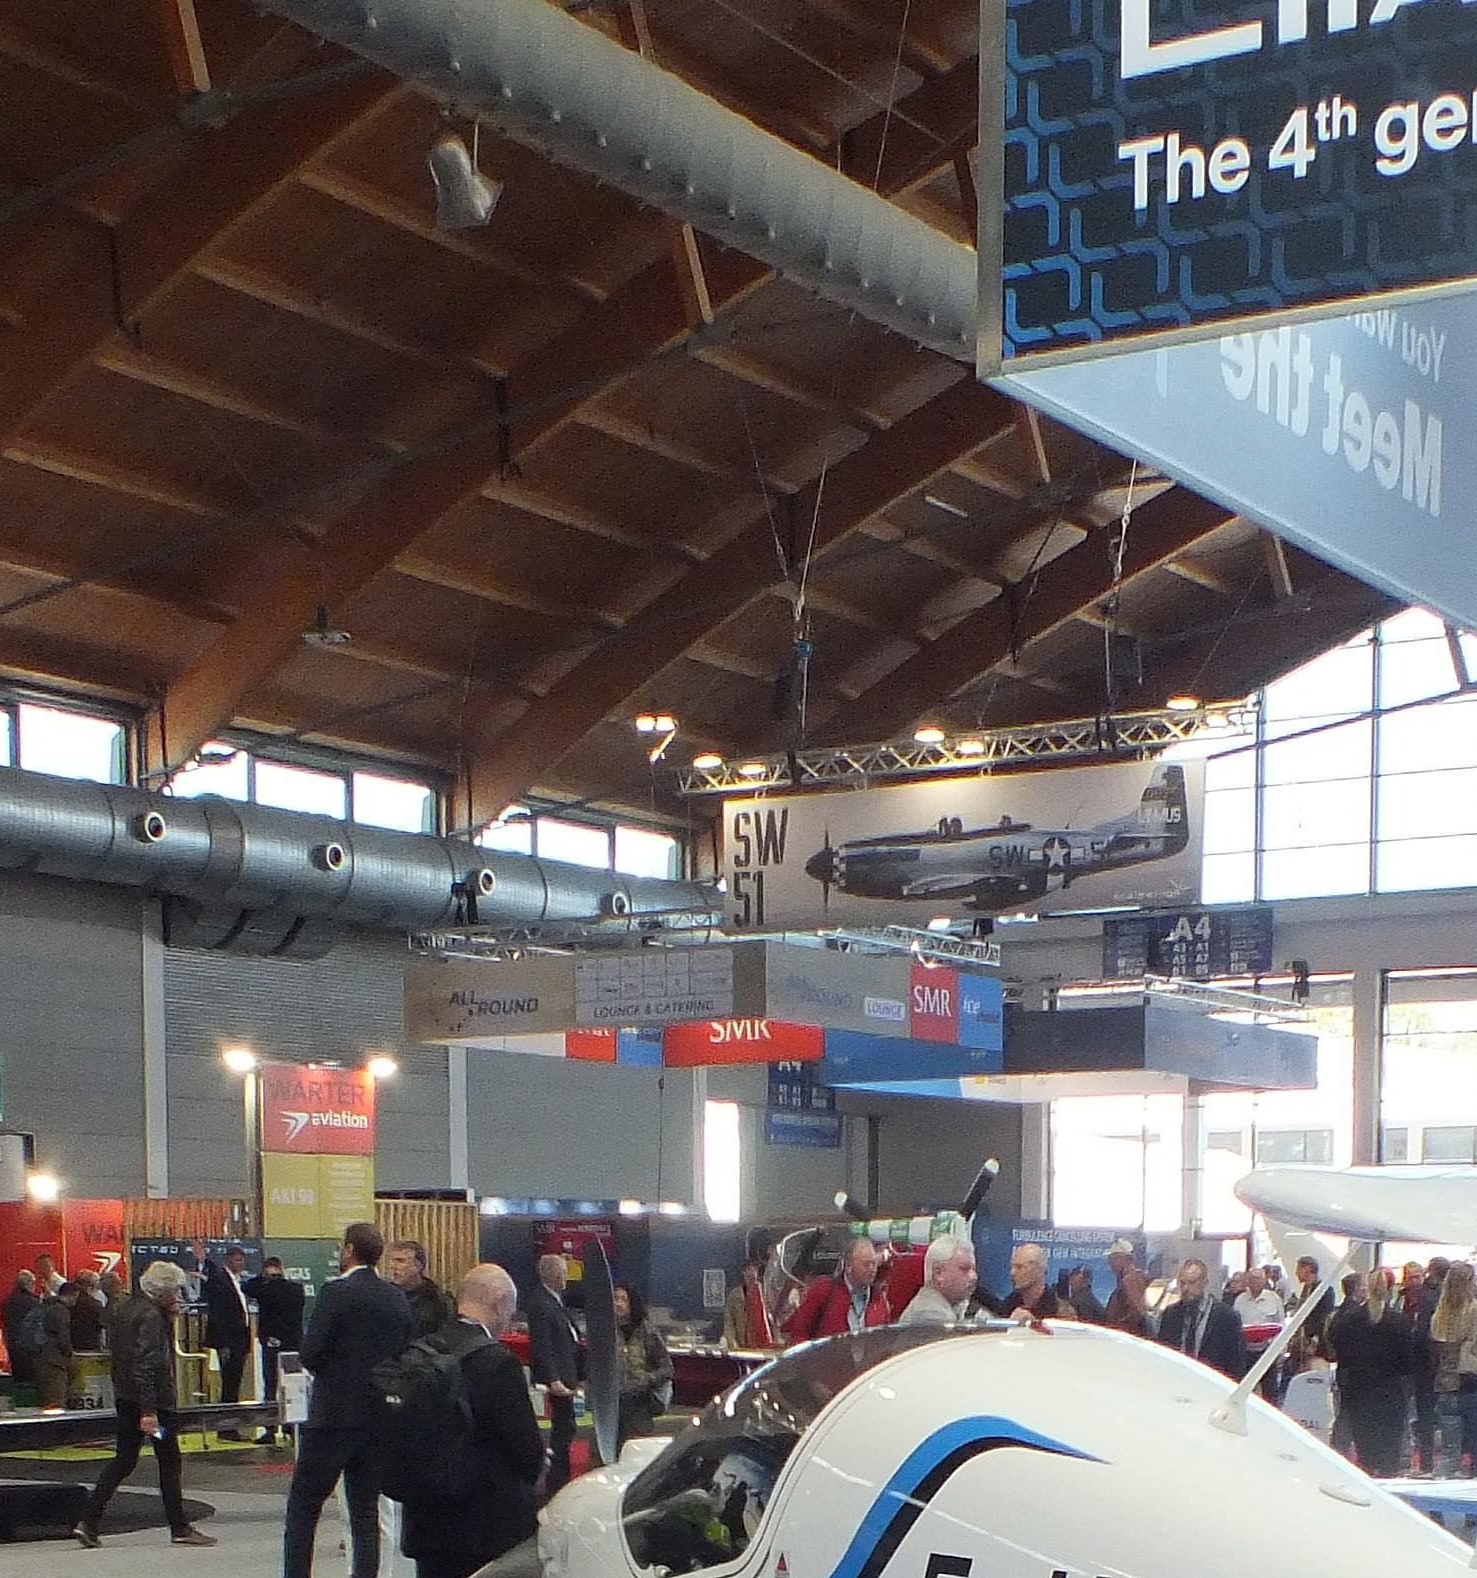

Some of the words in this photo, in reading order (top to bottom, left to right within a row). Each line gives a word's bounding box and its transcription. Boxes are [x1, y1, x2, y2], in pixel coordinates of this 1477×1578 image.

[1118, 130, 1251, 212] The
[1268, 95, 1357, 179] 4th
[732, 806, 789, 869] SW
[989, 845, 1024, 869] SW
[733, 871, 765, 928] 51
[1172, 905, 1212, 942] A4
[450, 989, 477, 1006] ALL
[476, 997, 539, 1017] ROUND
[593, 1004, 641, 1019] LOUNGE
[655, 999, 716, 1016] CATERING
[914, 985, 952, 1017] SMR
[963, 995, 981, 1014] ice
[311, 1109, 368, 1129] aviation
